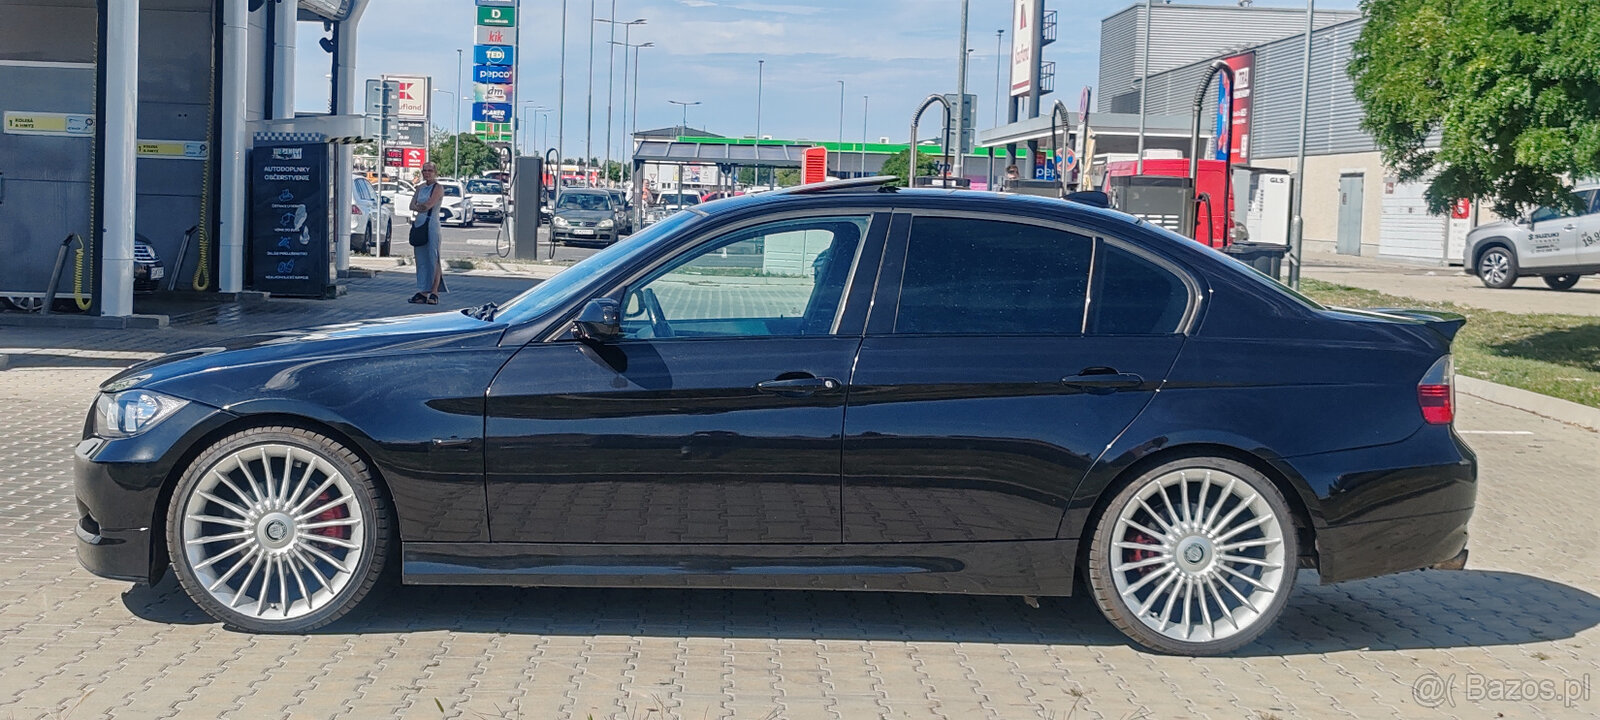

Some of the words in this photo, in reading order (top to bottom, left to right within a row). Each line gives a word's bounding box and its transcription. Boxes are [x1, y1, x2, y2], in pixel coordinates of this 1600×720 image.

[491, 9, 501, 18] D
[480, 70, 510, 78] pepco
[488, 86, 503, 95] dm
